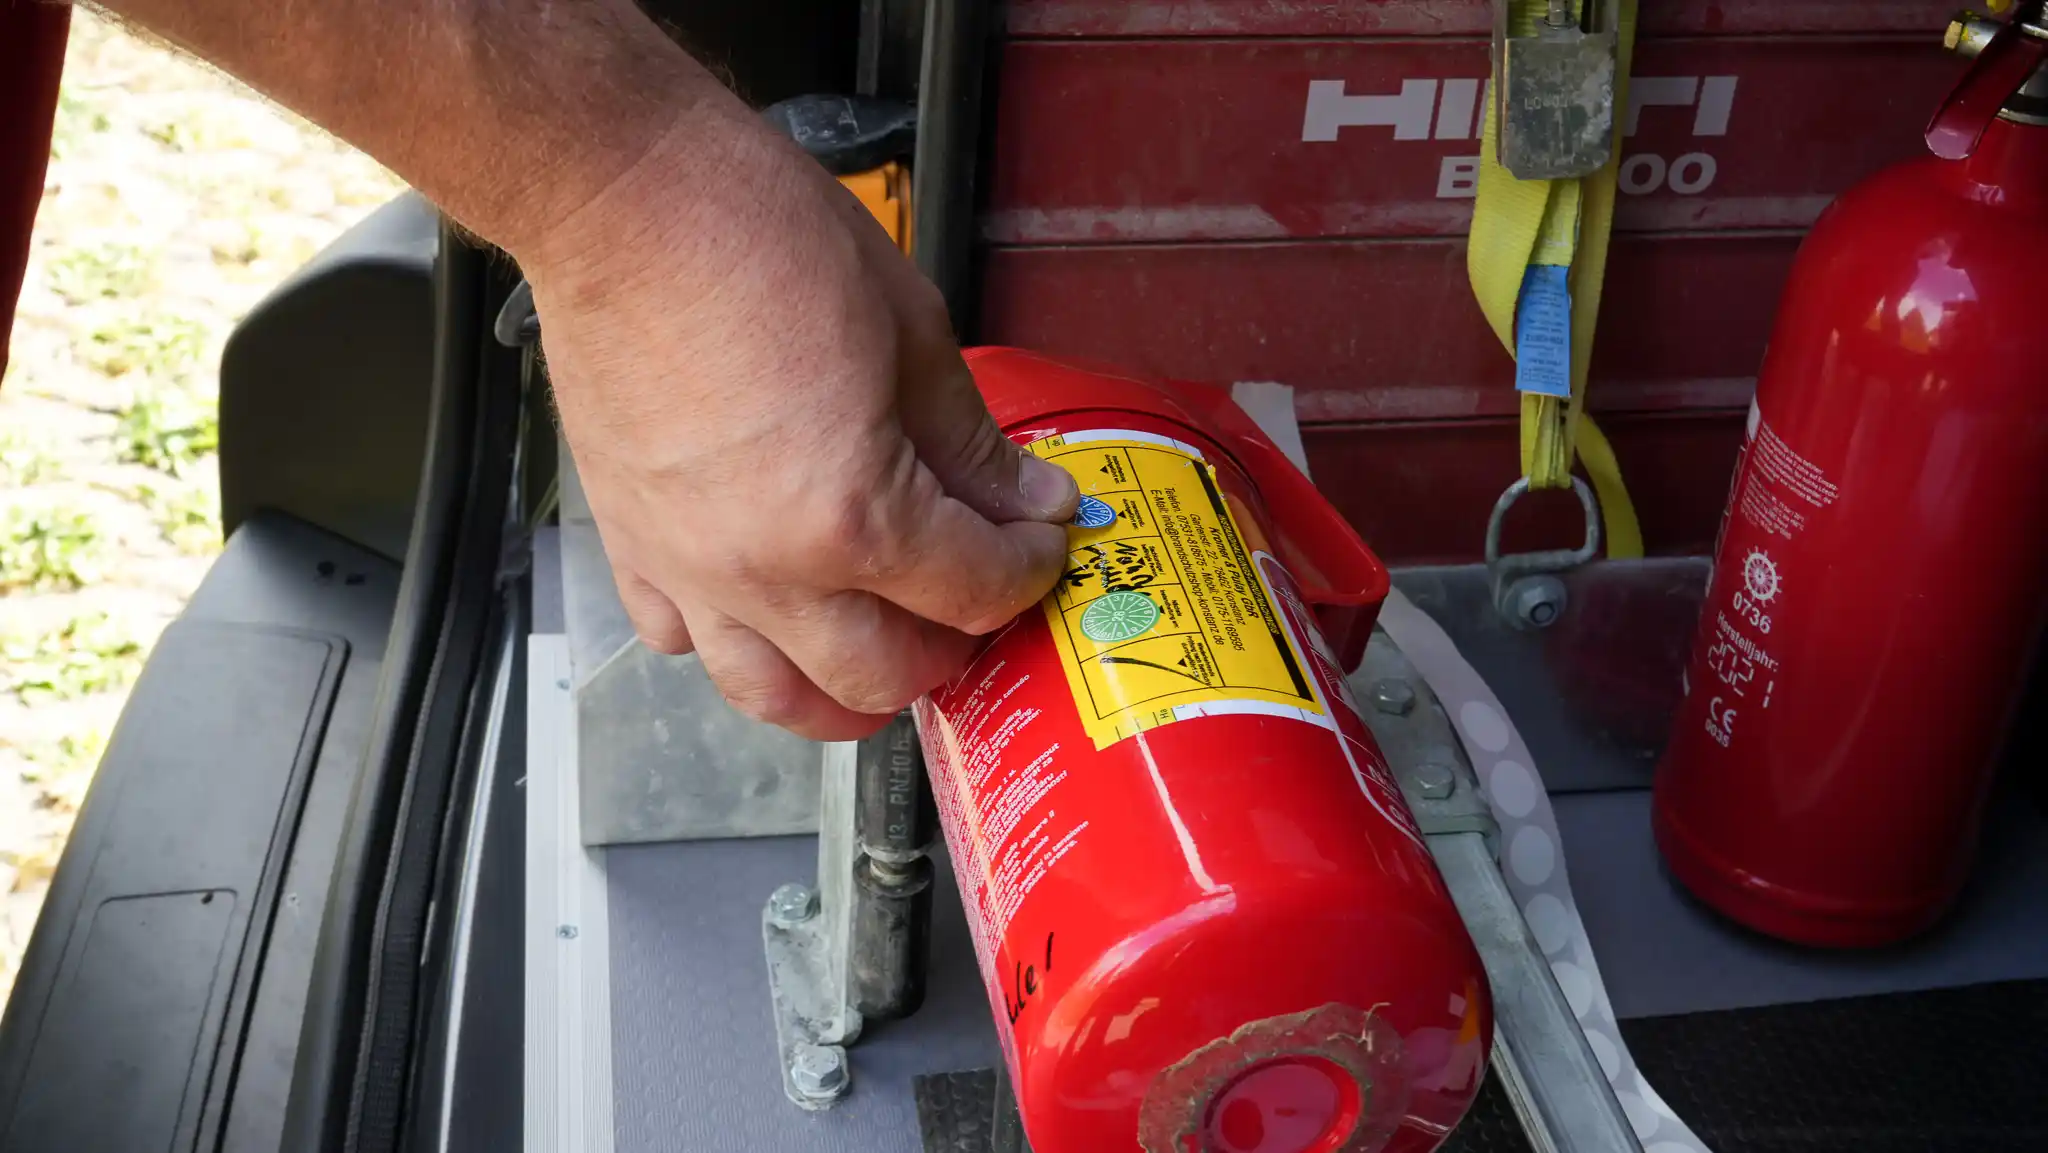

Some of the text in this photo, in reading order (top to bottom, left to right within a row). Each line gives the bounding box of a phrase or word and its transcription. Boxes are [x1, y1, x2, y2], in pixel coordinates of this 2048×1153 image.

[1150, 489, 1225, 645] E-Mail: info@brandschutzshop-konstanz.de
[1164, 487, 1181, 513] Telefon:
[1201, 572, 1219, 594] Mobil:
[1189, 514, 1212, 547] Gartenstr.
[1205, 550, 1219, 560] 22
[1212, 566, 1232, 588] 78462
[1223, 590, 1246, 625] Konstanz
[1208, 527, 1231, 561] Kromer
[1228, 570, 1247, 595] Pulay
[1241, 598, 1260, 618] GbR
[1717, 610, 1779, 673] Herstelljahr:
[1733, 591, 1771, 634] 0736
[1017, 709, 1042, 731] meter.
[1021, 743, 1060, 779] stisknout
[1052, 821, 1089, 852] tensione
